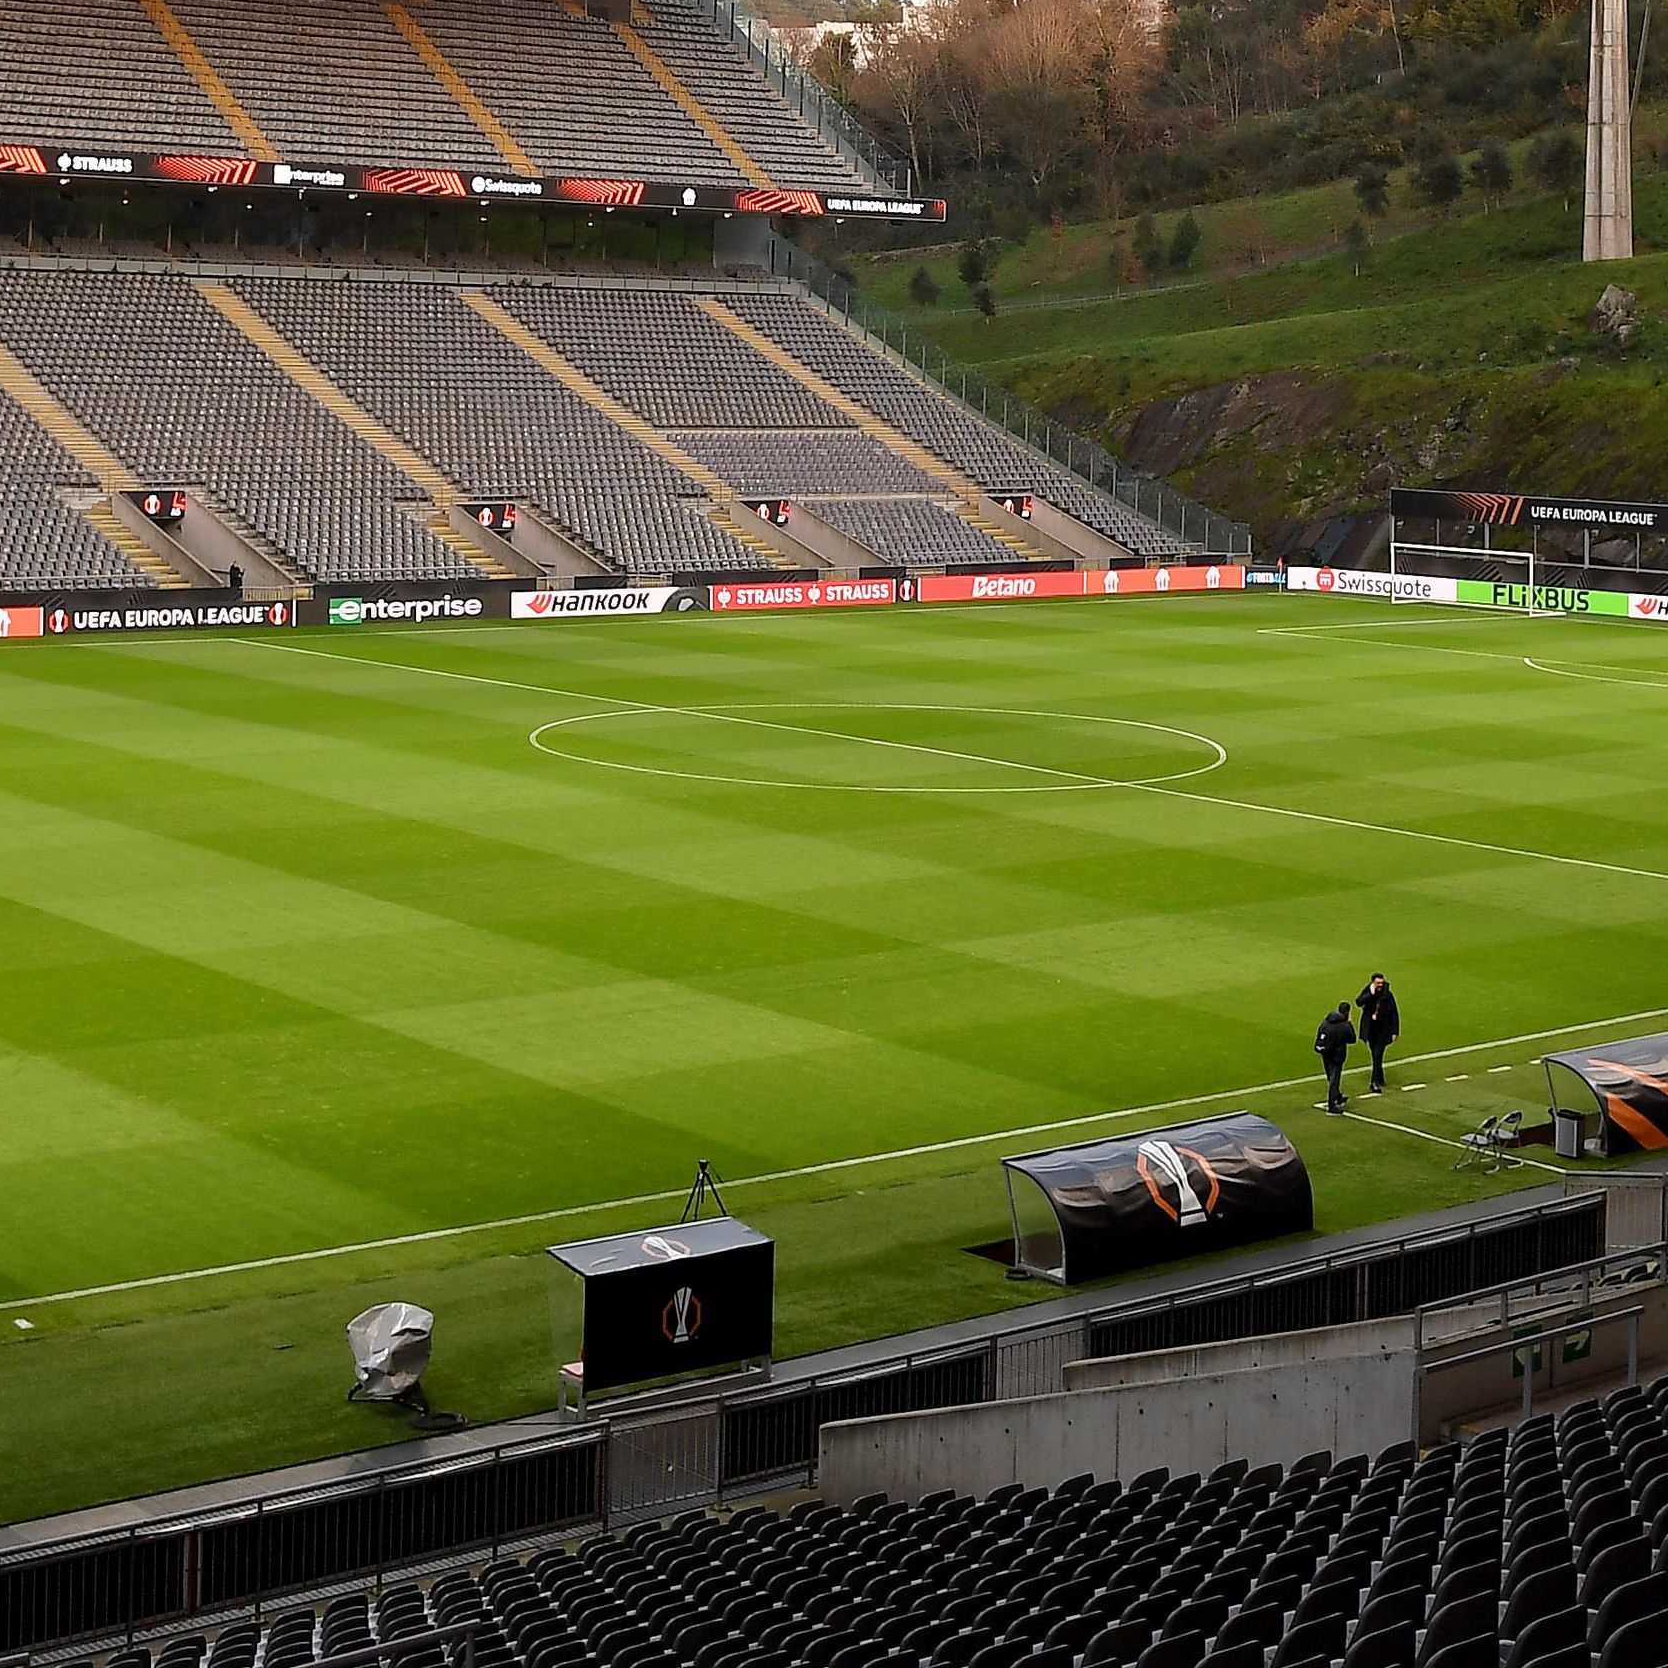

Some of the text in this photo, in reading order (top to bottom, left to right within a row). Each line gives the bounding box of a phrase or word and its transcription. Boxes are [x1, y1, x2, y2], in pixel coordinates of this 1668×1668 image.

[73, 156, 133, 173] STRAUSS
[827, 198, 851, 211] UEFA
[1531, 505, 1655, 526] UEFA EUROPA LEAGUE
[736, 583, 890, 606] STRAUSS STRAUSS
[972, 575, 1037, 598] Betano
[1338, 571, 1432, 599] Swissquote
[73, 605, 265, 630] UEFA EUROPA LEAGUE
[336, 594, 483, 623] enterprise
